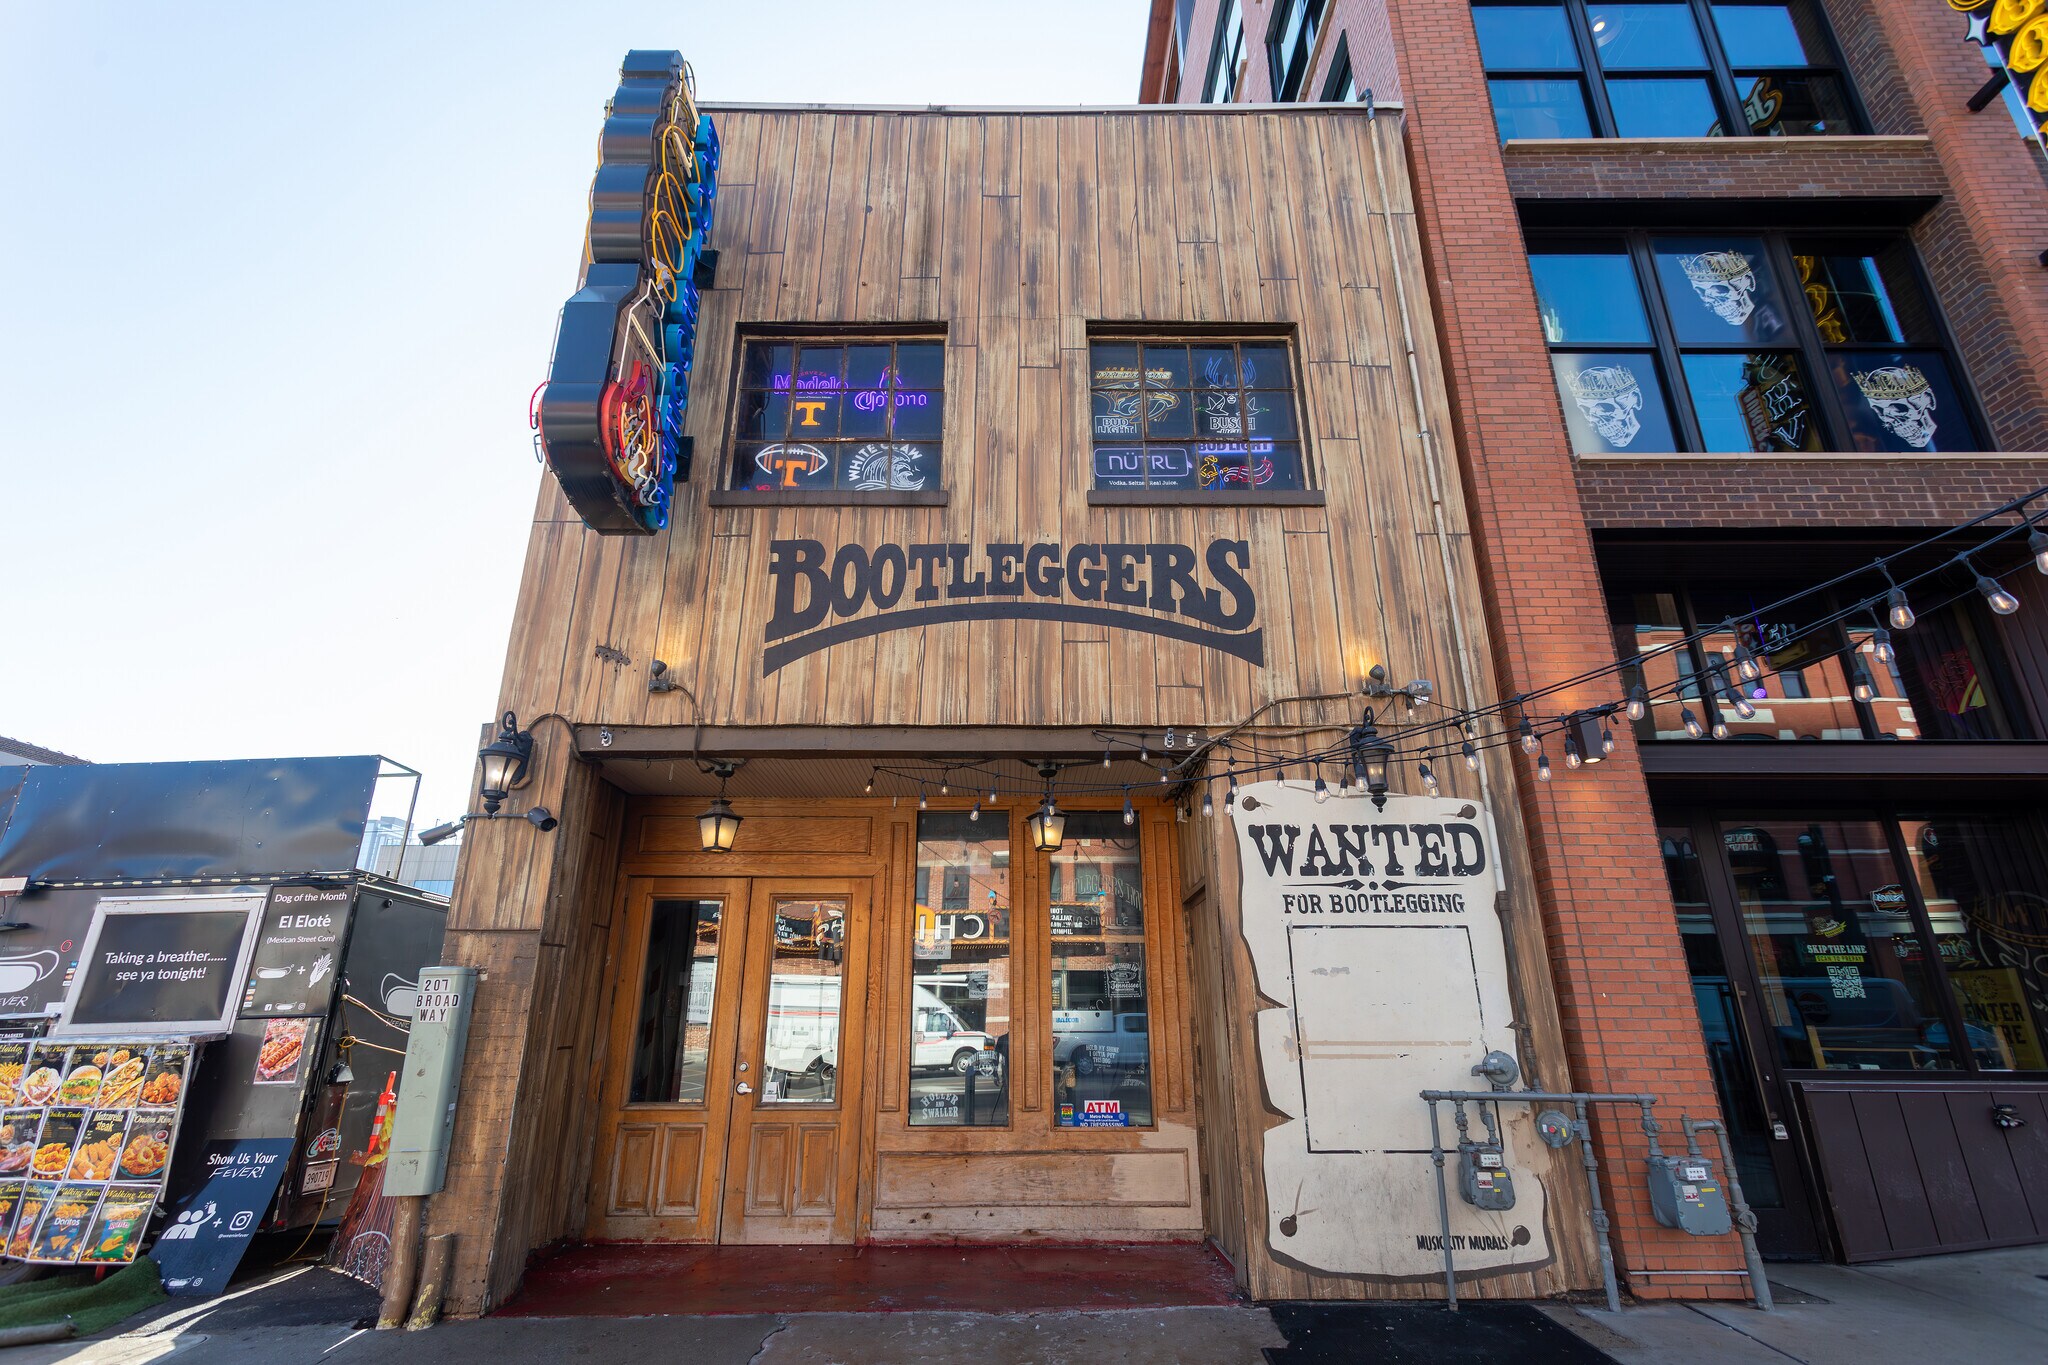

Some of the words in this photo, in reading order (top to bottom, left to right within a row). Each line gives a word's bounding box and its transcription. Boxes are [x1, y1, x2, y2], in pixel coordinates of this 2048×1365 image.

[774, 375, 849, 395] Modelo
[854, 391, 927, 411] Coona
[849, 444, 878, 481] WHITE
[765, 539, 1256, 643] BOOTLEGGERS
[1248, 823, 1486, 877] WANTED
[275, 894, 292, 903] Dog
[293, 893, 303, 902] of
[304, 893, 318, 901] the
[320, 892, 347, 901] Month
[1282, 894, 1324, 914] FOR
[1330, 894, 1465, 914] BOOTLEGGING
[279, 915, 292, 928] El
[295, 914, 331, 928] Eloté
[317, 935, 336, 943] Corn)
[1807, 945, 1827, 953] SKIP
[1828, 945, 1846, 953] THE
[1846, 945, 1867, 953] LINE
[105, 952, 145, 965] Taking
[146, 954, 154, 962] a
[116, 972, 137, 981] see
[140, 972, 154, 982] ya
[158, 967, 206, 981] tonight!
[425, 979, 449, 991] 207
[417, 995, 459, 1007] BROAD
[420, 1009, 447, 1021] WAY
[920, 1093, 959, 1107] HOLLER
[922, 1108, 959, 1119] SWALLER
[1086, 1102, 1119, 1113] ATM
[207, 1153, 235, 1166] Show
[237, 1153, 251, 1164] Us
[253, 1153, 278, 1164] Your
[208, 1165, 266, 1179] FEVER!
[306, 1171, 330, 1184] 390719
[107, 1190, 137, 1200] Walking
[1416, 1235, 1445, 1251] MUSIC
[1468, 1235, 1508, 1251] MURALS
